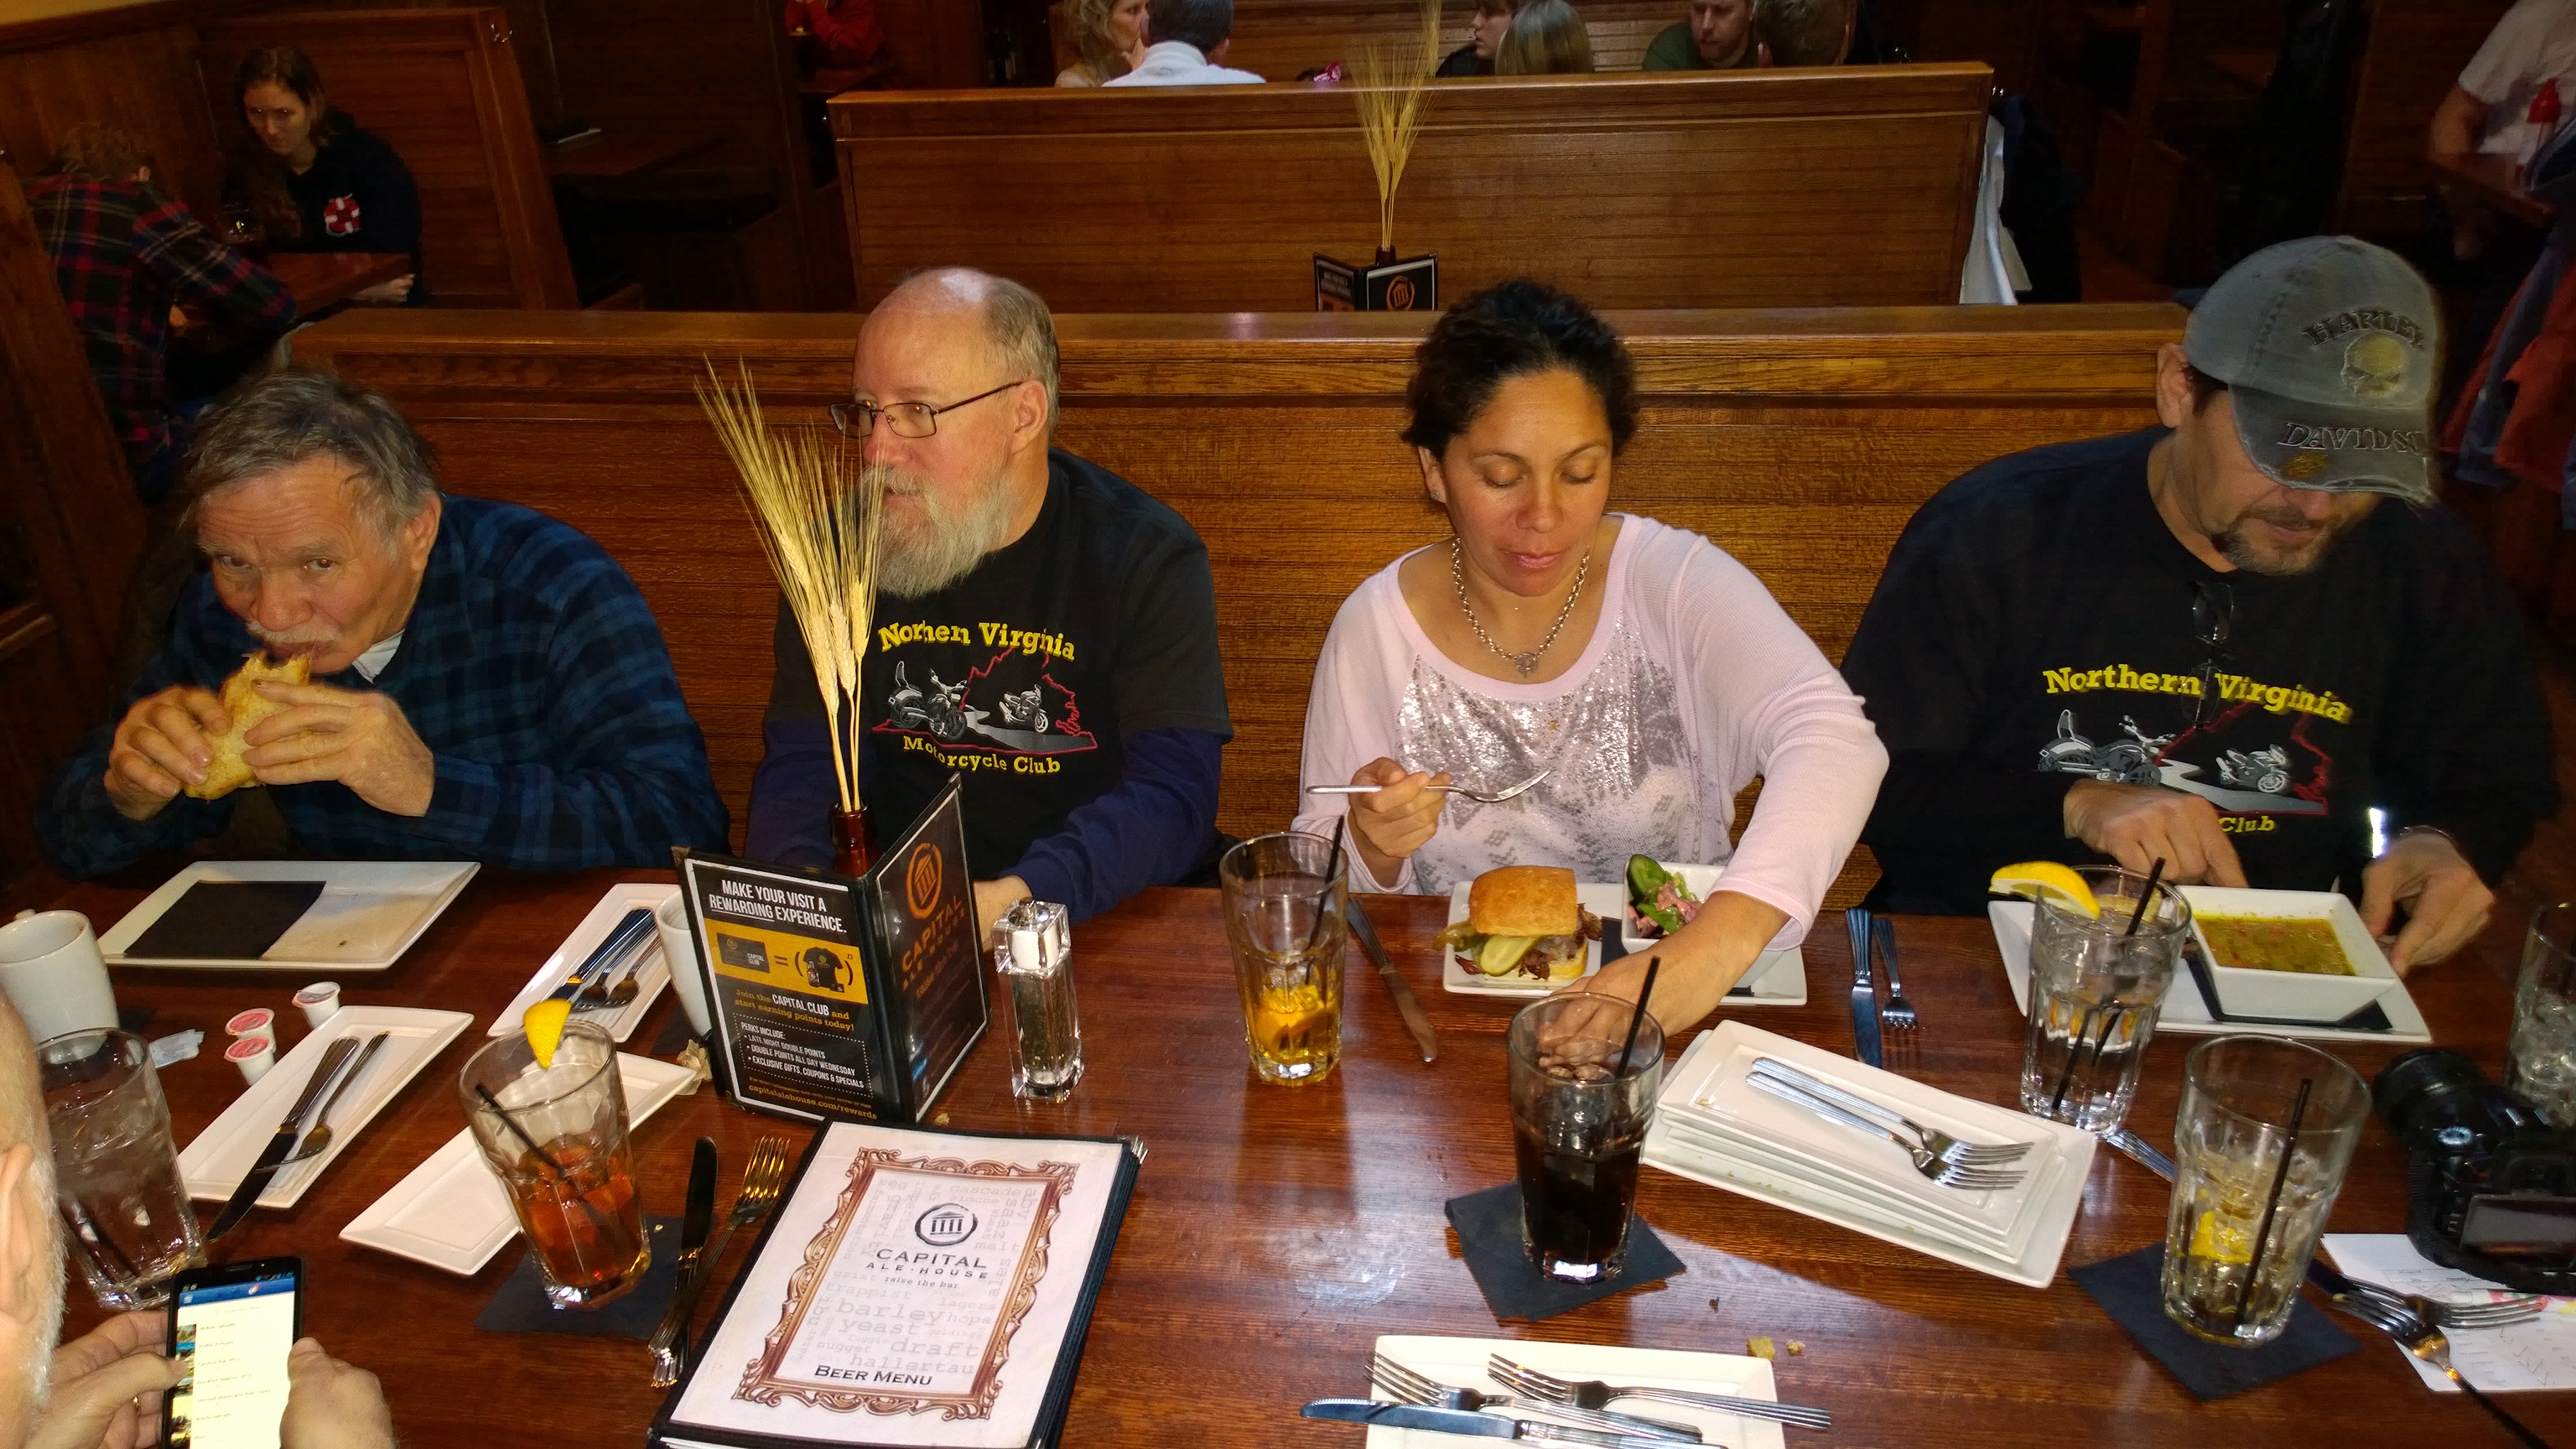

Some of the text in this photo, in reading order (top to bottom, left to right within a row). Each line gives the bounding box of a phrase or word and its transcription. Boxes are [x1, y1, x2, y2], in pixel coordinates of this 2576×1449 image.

[2302, 307, 2424, 351] HARLEY
[2043, 663, 2350, 724] Northern Virginia
[903, 736, 1061, 774] Motorcycle Club
[2218, 815, 2275, 833] Club
[722, 880, 827, 912] MAKE YOUR VISIT A
[709, 894, 847, 933] REWARDING EXPERIENCE.
[902, 896, 962, 974] CAPITAL
[735, 1000, 854, 1031] start earning points today!
[736, 989, 849, 1020] Join the CAPITAL CLUB and
[740, 1021, 787, 1040] PERKS INCLUDE:
[748, 1034, 826, 1059] LATE NIGHT DOUBLE POINTS
[751, 1045, 855, 1077] DOUBLE POINTS ALL DAY WEDNESDAY
[752, 1056, 784, 1070] EXCLUSIVE
[802, 1067, 830, 1081] COUPONS
[830, 1074, 835, 1083] &
[835, 1075, 865, 1088] SPECIALS
[748, 1084, 878, 1120] capitalalehouse.com/rewards
[875, 1177, 909, 1190] keg
[948, 1182, 1022, 1197] cascade
[948, 1193, 1000, 1204] simcoe
[1015, 1187, 1041, 1220] abv
[992, 1198, 1018, 1239] saaz
[974, 1239, 1021, 1252] malt
[874, 1248, 989, 1269] CAPITAL
[832, 1270, 878, 1281] grist
[884, 1275, 914, 1285] raise
[984, 1258, 1011, 1296] ales
[823, 1282, 914, 1301] trappist
[832, 1298, 948, 1326] barley
[938, 1297, 997, 1311] lagers
[838, 1317, 922, 1337] yeast
[946, 1311, 992, 1327] hops
[815, 1341, 873, 1353] nugget
[888, 1337, 982, 1358] draft
[813, 1364, 934, 1386] BEER MENU
[848, 1353, 975, 1376] hallertau
